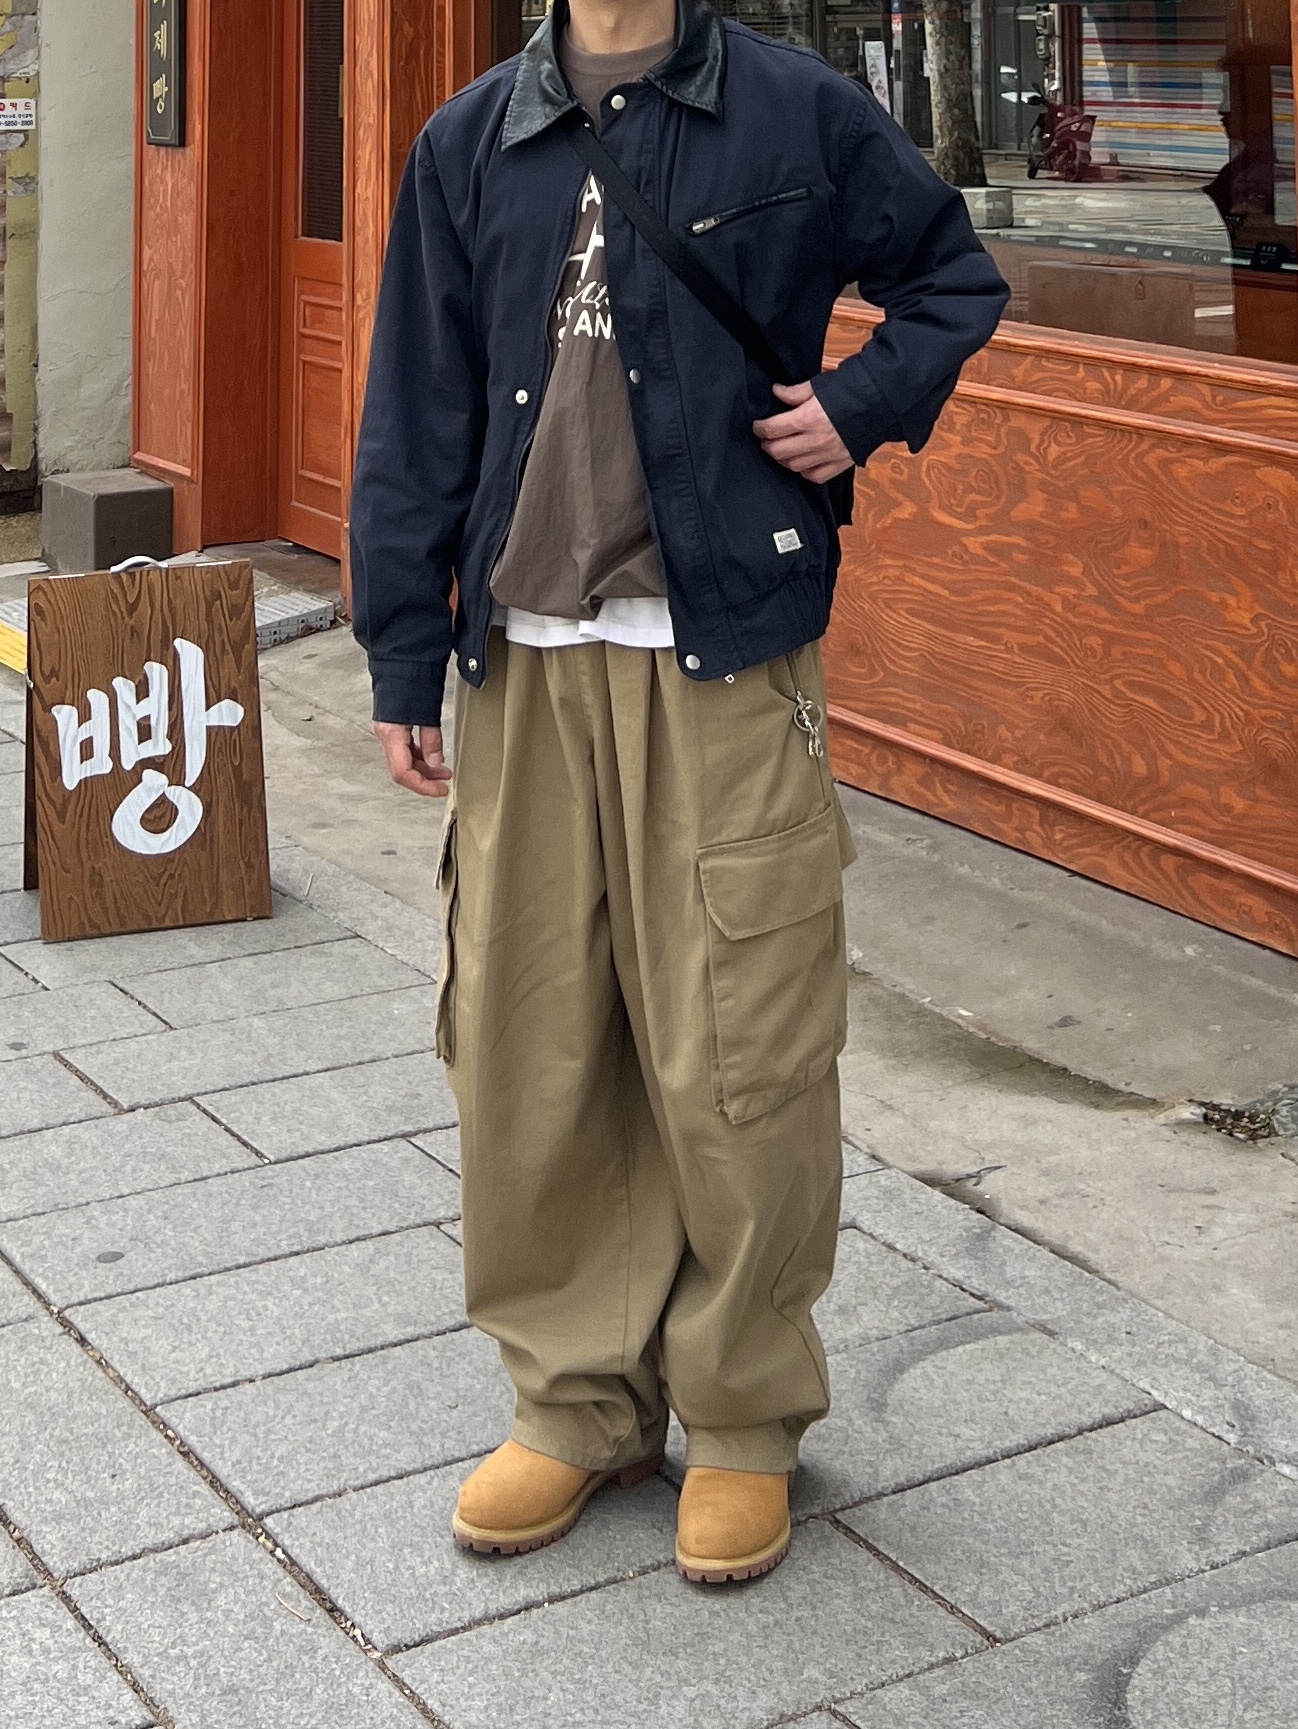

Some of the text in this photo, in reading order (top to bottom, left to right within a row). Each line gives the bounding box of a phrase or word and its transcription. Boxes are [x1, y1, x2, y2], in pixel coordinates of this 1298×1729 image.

[152, 0, 169, 115] 제빵
[581, 174, 605, 213] A
[51, 637, 245, 856] 빵
